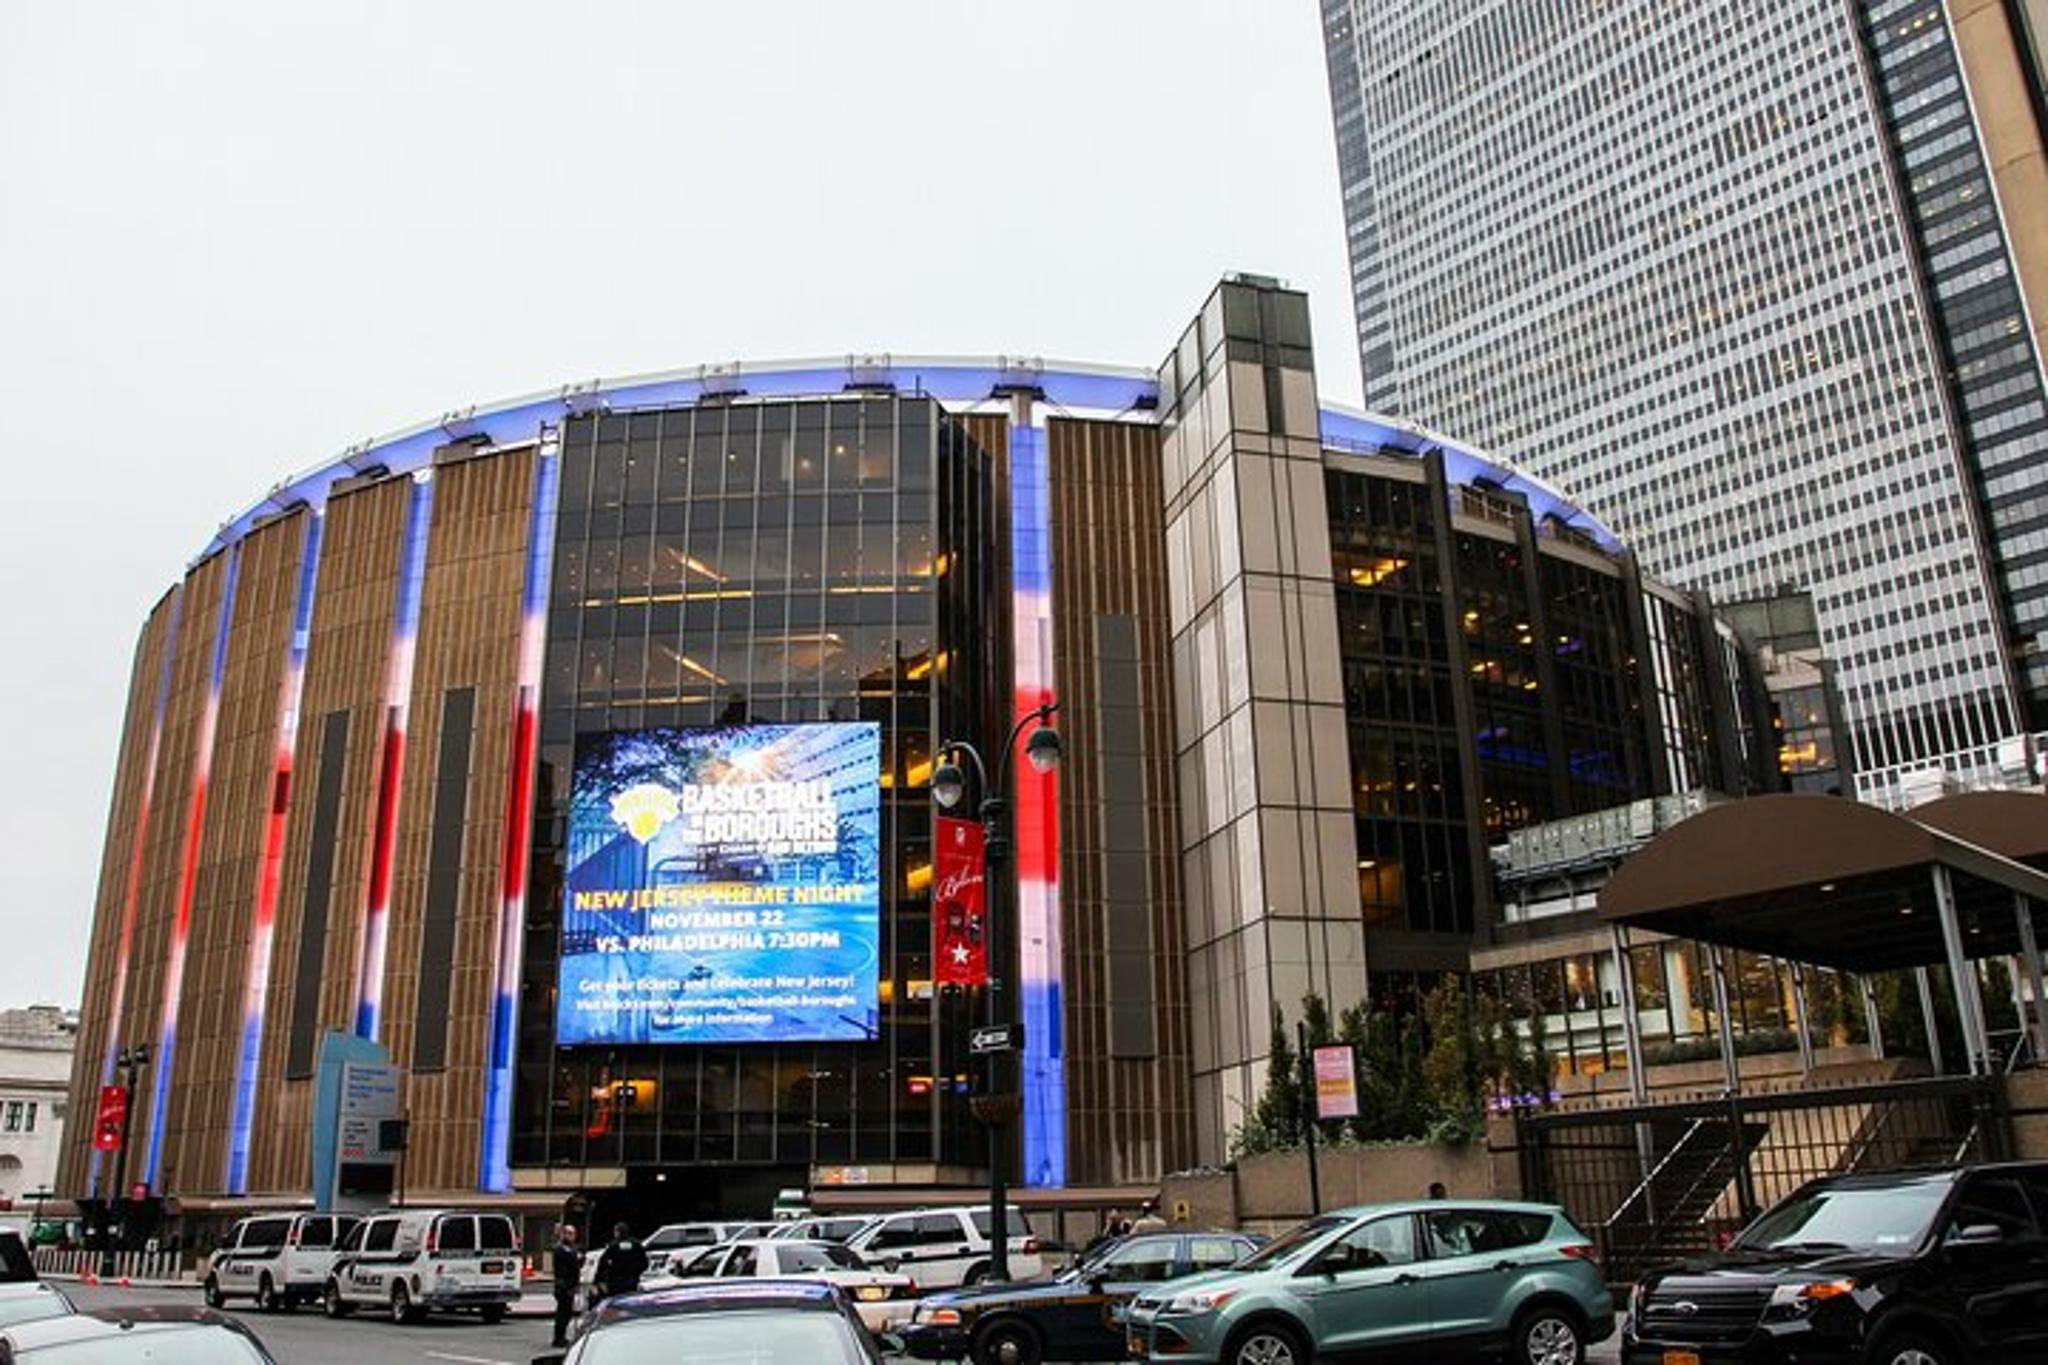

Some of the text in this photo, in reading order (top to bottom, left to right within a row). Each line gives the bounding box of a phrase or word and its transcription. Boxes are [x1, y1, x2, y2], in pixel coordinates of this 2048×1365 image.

[683, 780, 836, 812] BASKETBALL
[705, 809, 836, 842] BOROUGHS
[575, 884, 864, 912] NEW JERSEY THEME NIGHT
[651, 909, 784, 929] NOVEMBER 22
[596, 930, 840, 953] VS. PHILADELPHIA 7:30PM
[776, 975, 804, 988] New
[705, 1011, 774, 1025] information
